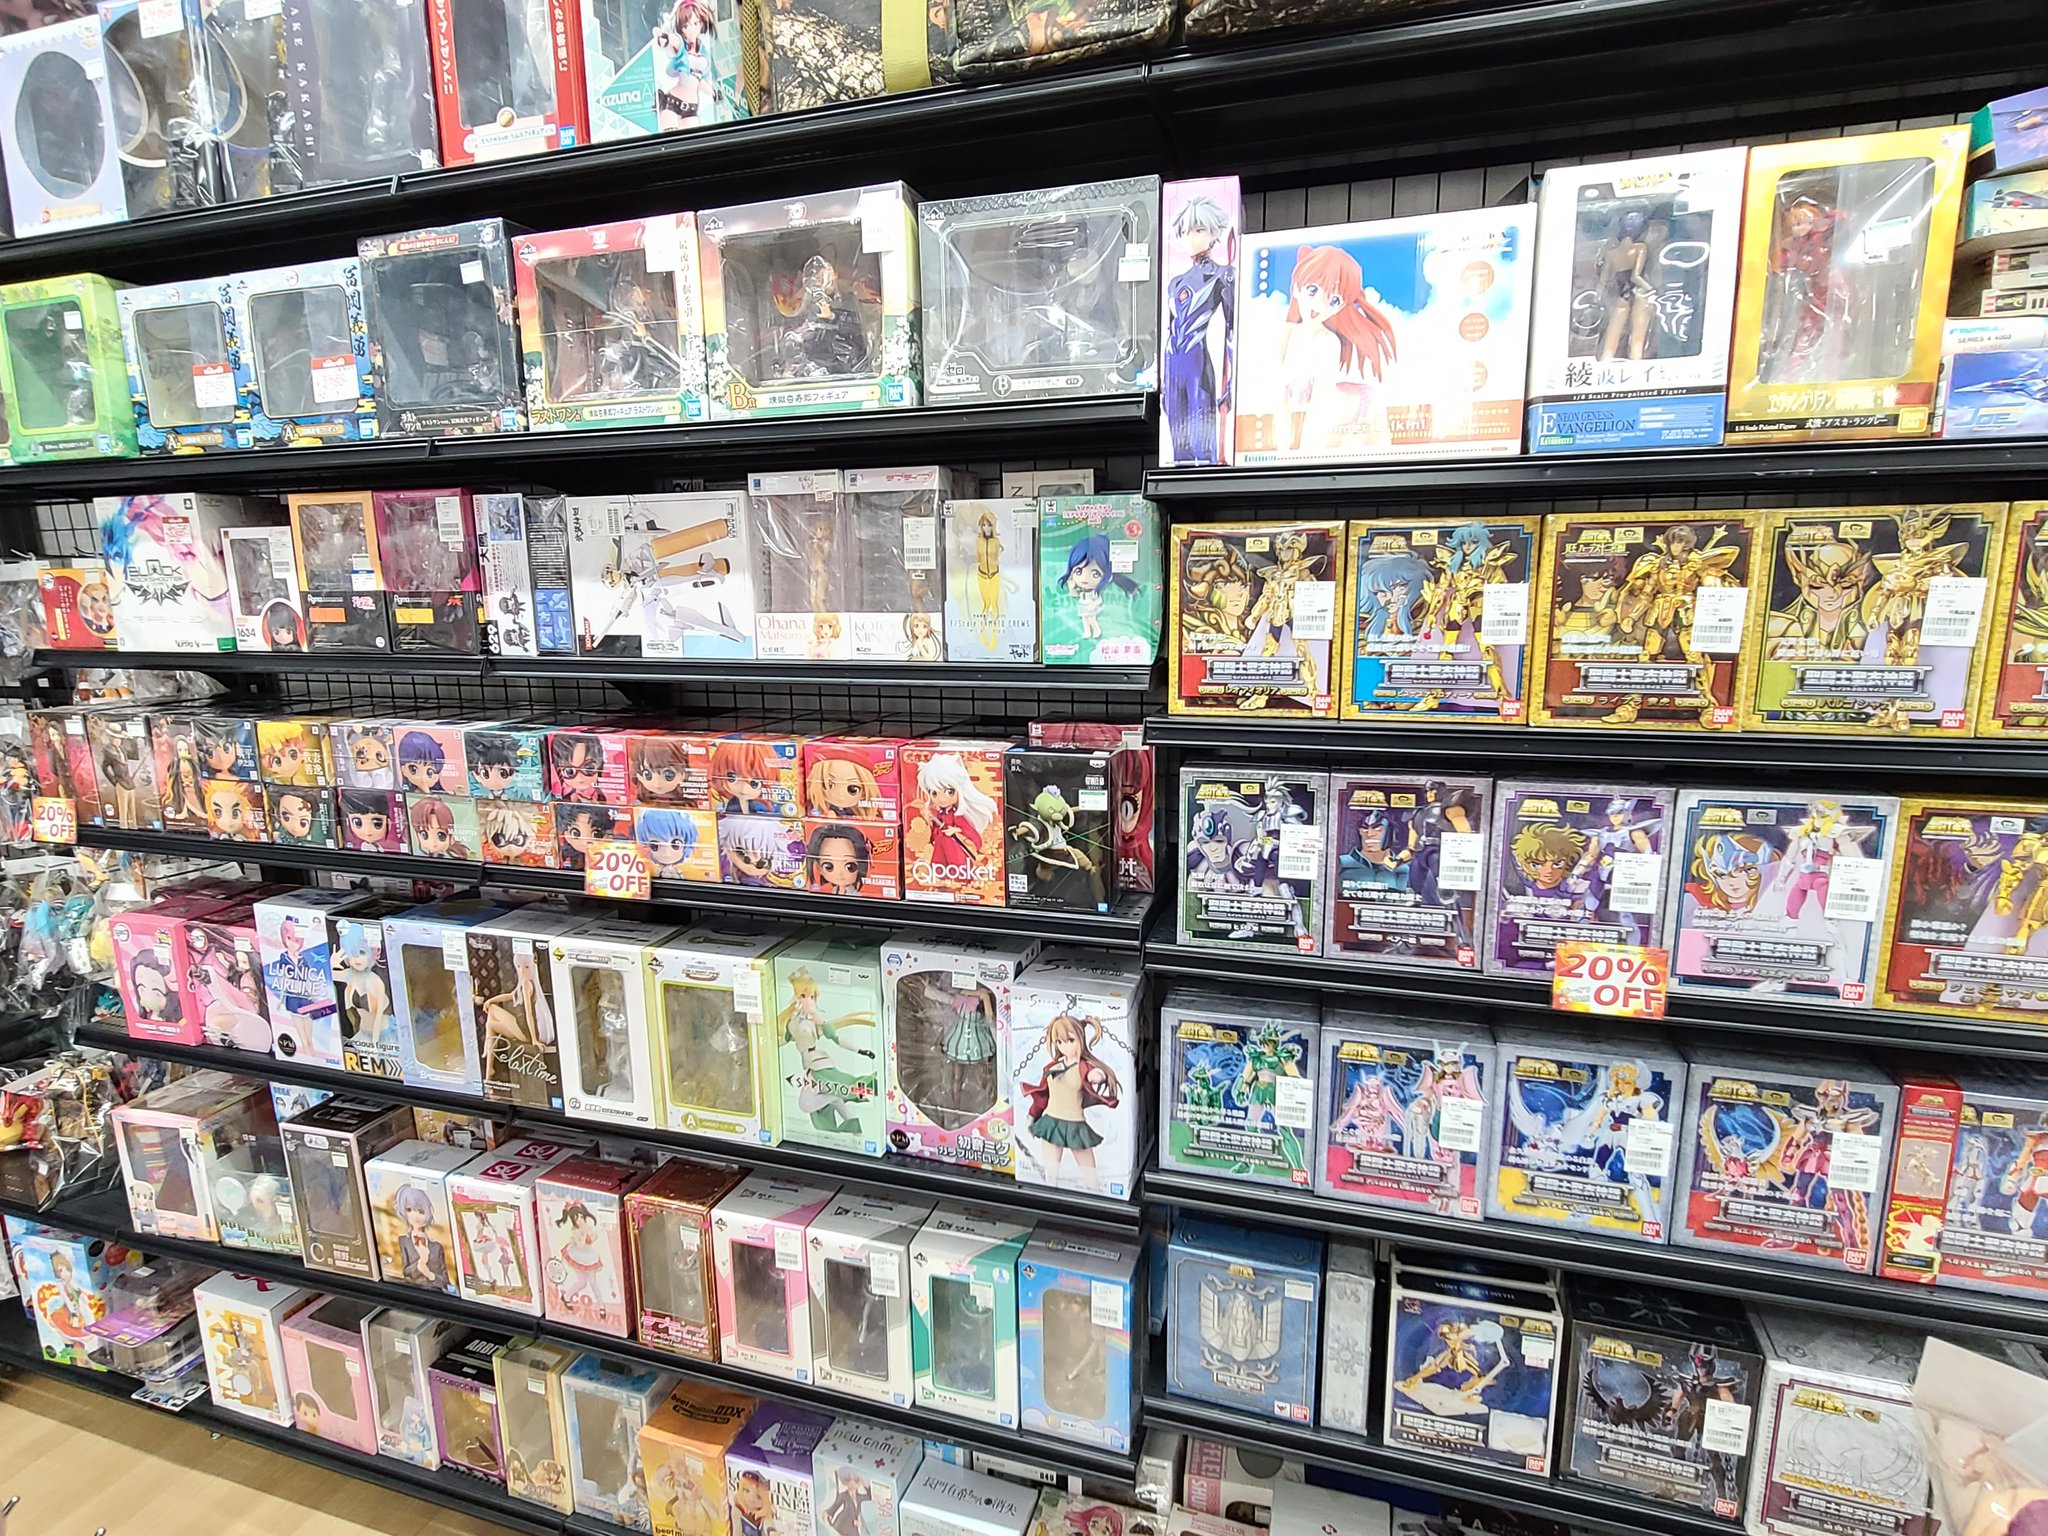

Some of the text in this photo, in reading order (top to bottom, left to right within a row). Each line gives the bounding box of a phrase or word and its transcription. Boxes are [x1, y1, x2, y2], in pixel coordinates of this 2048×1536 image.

[1540, 411, 1635, 434] EVANGELION
[1557, 411, 1580, 422] NEON
[758, 615, 806, 631] Ohana
[236, 627, 256, 639] 1634
[486, 623, 500, 654] 629
[1713, 708, 1734, 716] BAN
[1942, 711, 1965, 721] BAN
[35, 804, 74, 823] 20%
[49, 822, 75, 838] OFF
[589, 851, 646, 875] 20%
[608, 874, 649, 893] OFF
[268, 961, 327, 982] LUGNICA
[1557, 952, 1662, 986] 20%
[270, 978, 328, 997] AIRLINES
[1843, 984, 1865, 993] BAN
[1592, 984, 1664, 1011] OFF
[344, 1049, 388, 1075] REM
[956, 1133, 1011, 1156] 初音ミク
